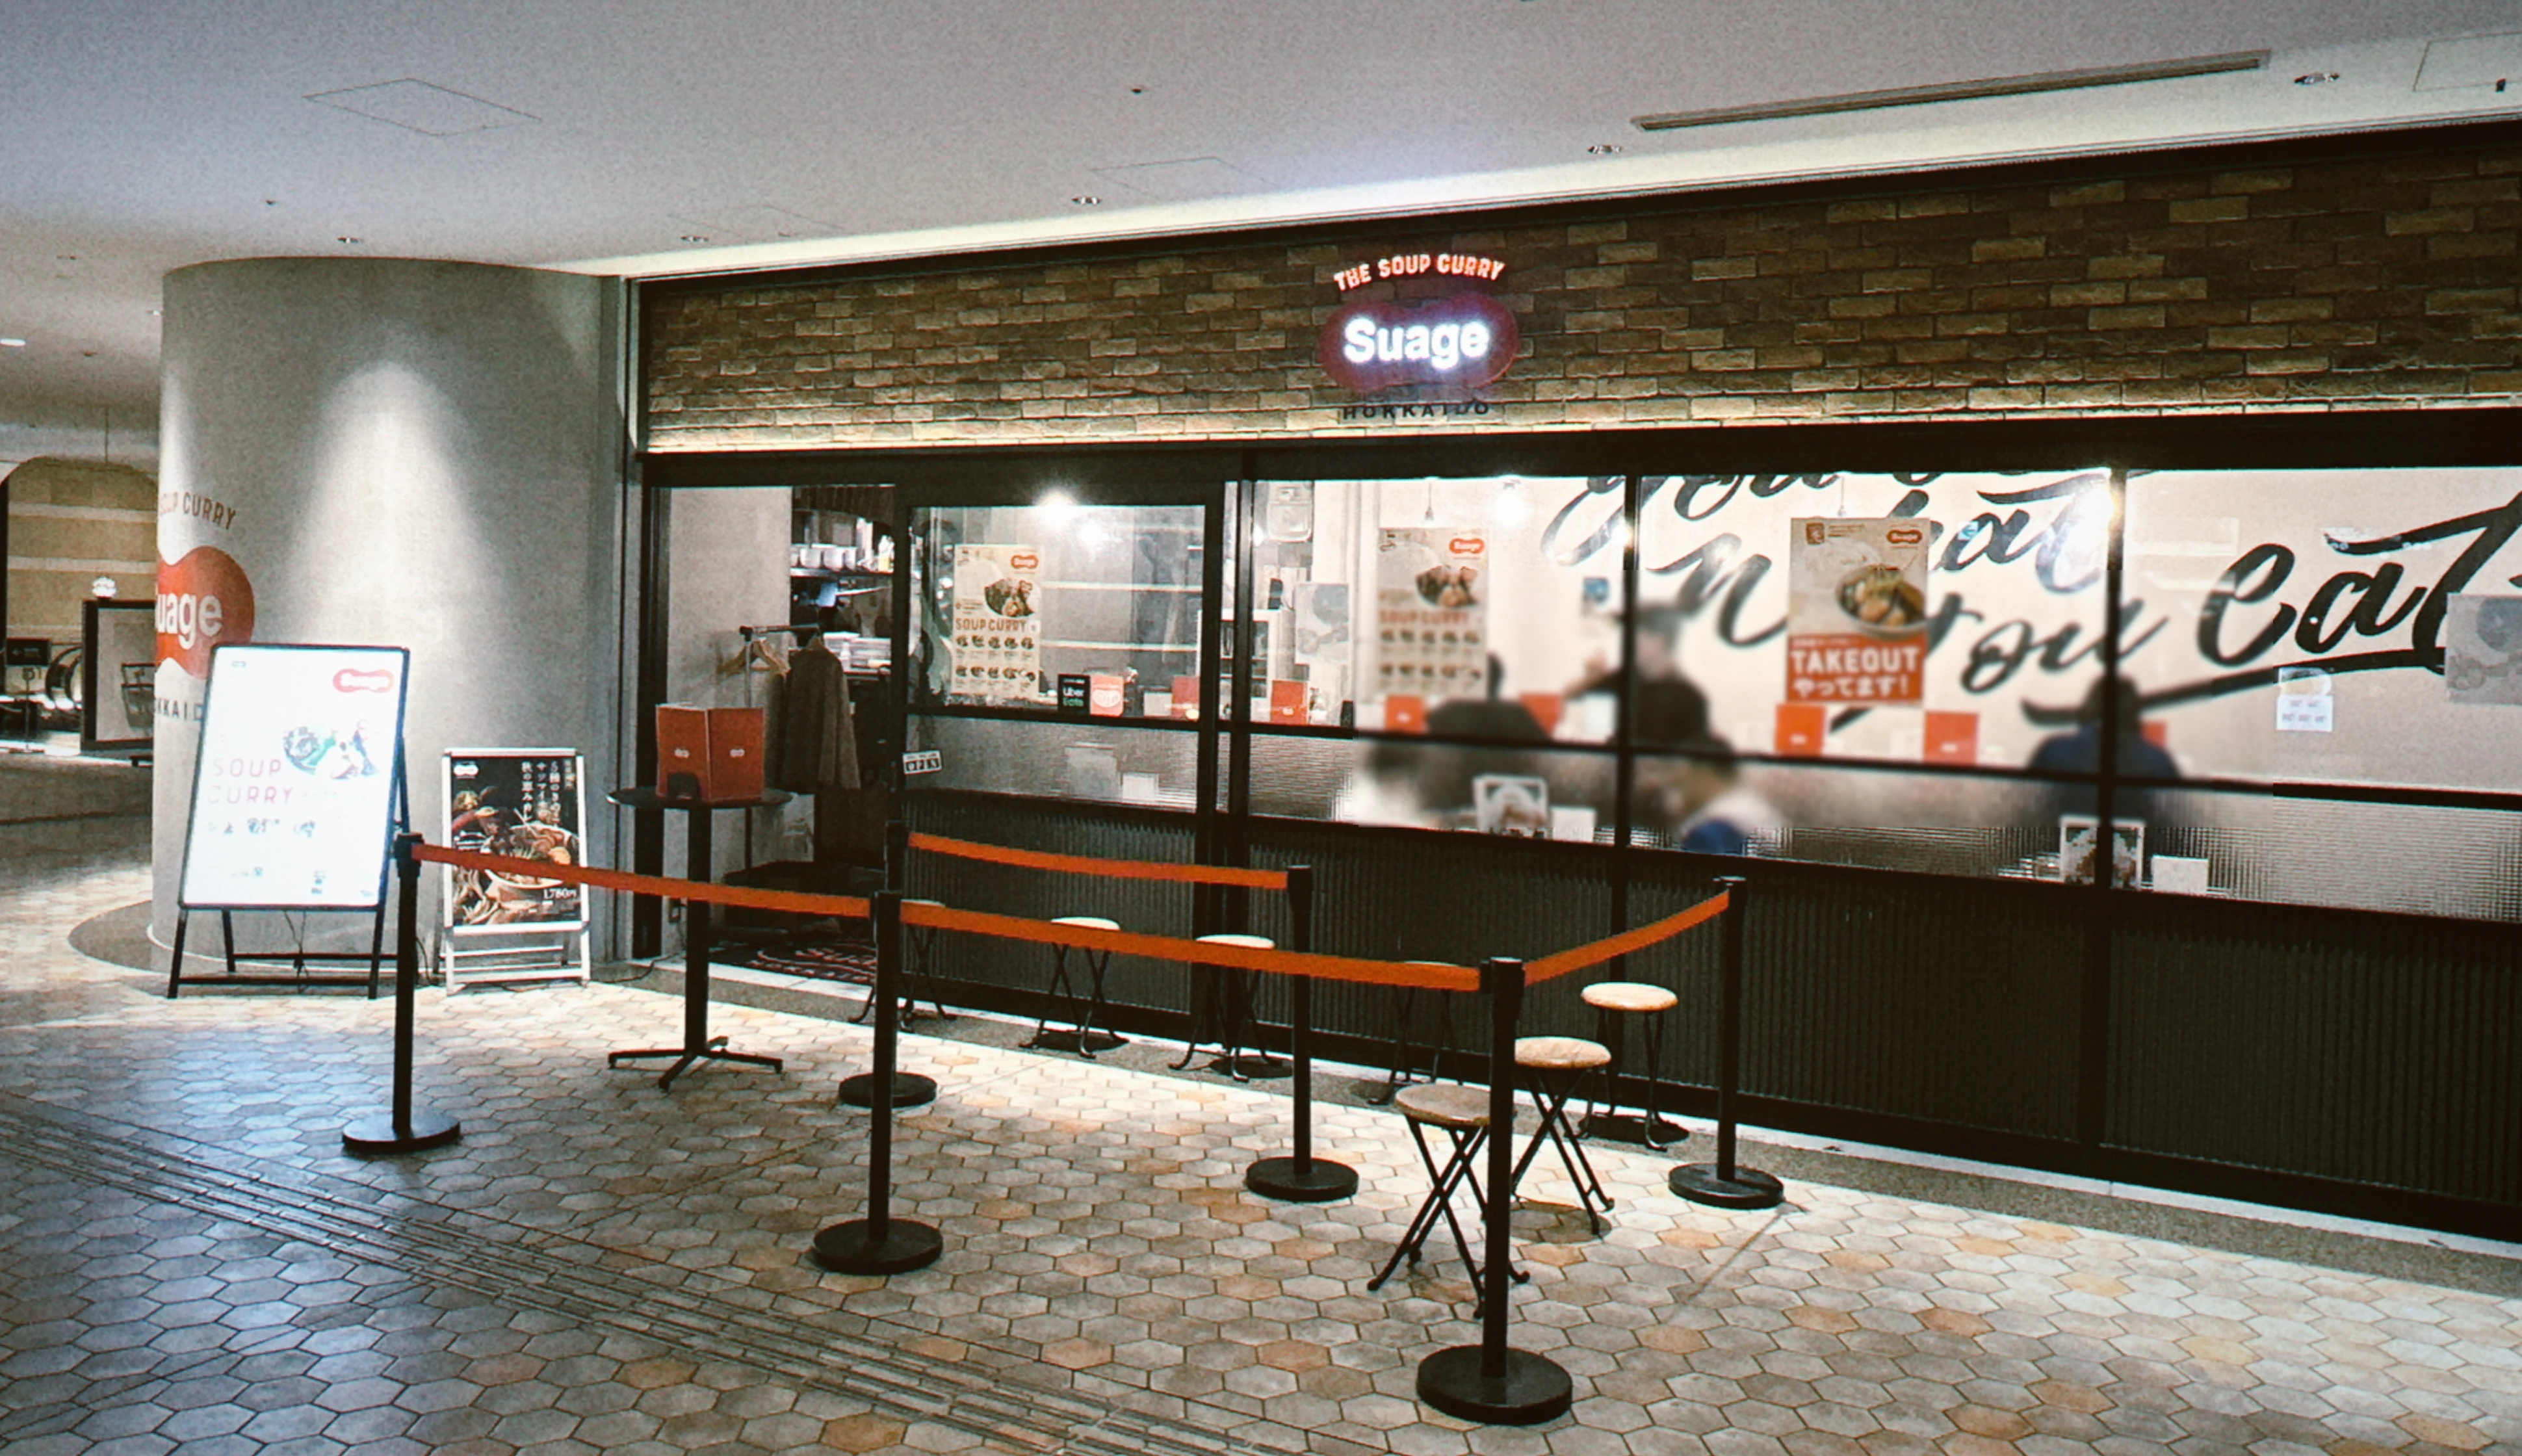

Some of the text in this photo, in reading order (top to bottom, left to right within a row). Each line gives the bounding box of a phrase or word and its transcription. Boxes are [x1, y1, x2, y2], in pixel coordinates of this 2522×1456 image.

[1333, 253, 1505, 292] THE SOUP CURRY
[1344, 317, 1490, 371] Suage
[1342, 400, 1489, 420] HOKKAIDO
[183, 491, 237, 530] CURRY
[155, 592, 222, 650] uage
[956, 618, 1026, 632] SOUP CURRY
[1791, 647, 1920, 674] TAKEOUT
[212, 758, 281, 777] SOUP
[207, 785, 293, 804] CURRY
